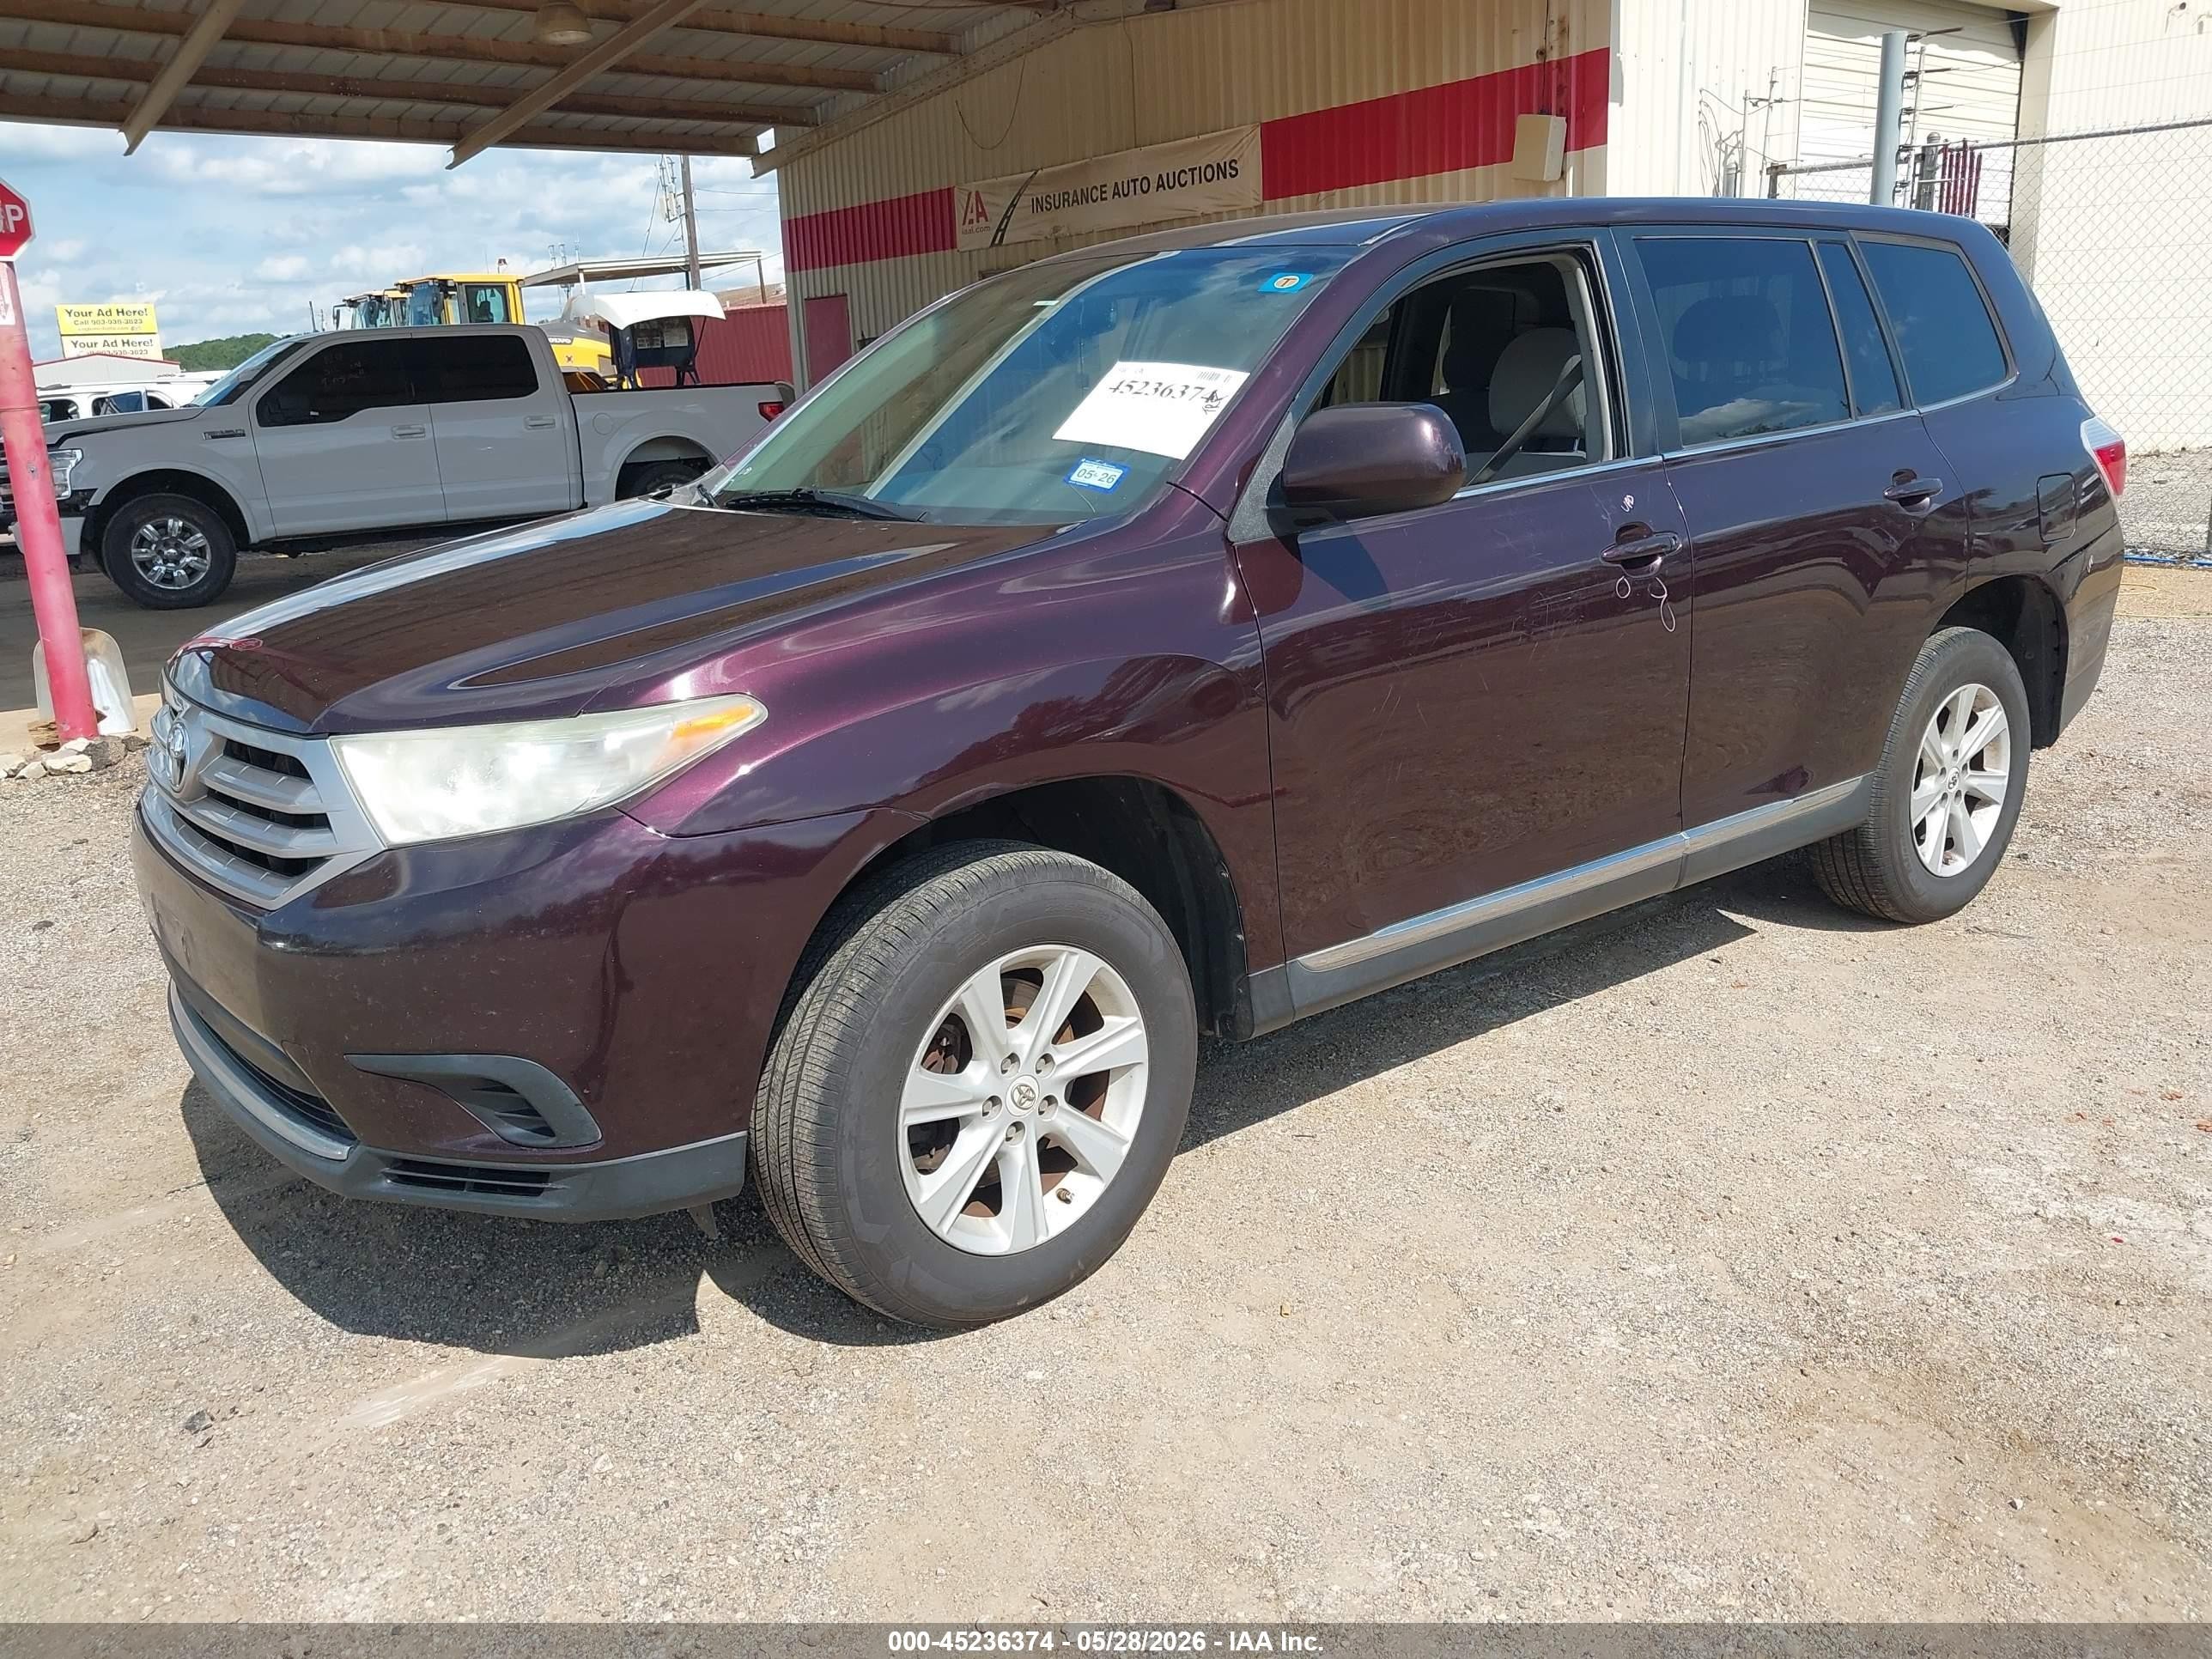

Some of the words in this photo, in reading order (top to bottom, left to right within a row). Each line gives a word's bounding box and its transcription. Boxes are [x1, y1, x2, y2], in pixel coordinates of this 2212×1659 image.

[1031, 184, 1109, 214] INSURANCE
[1112, 175, 1152, 199] AUTO
[1156, 159, 1239, 193] AUCTIONS
[64, 308, 93, 318] Your
[96, 308, 112, 317] Ad
[116, 307, 149, 317] Here!
[70, 340, 99, 349] Your
[102, 339, 118, 348] Ad
[121, 338, 154, 347] Here!
